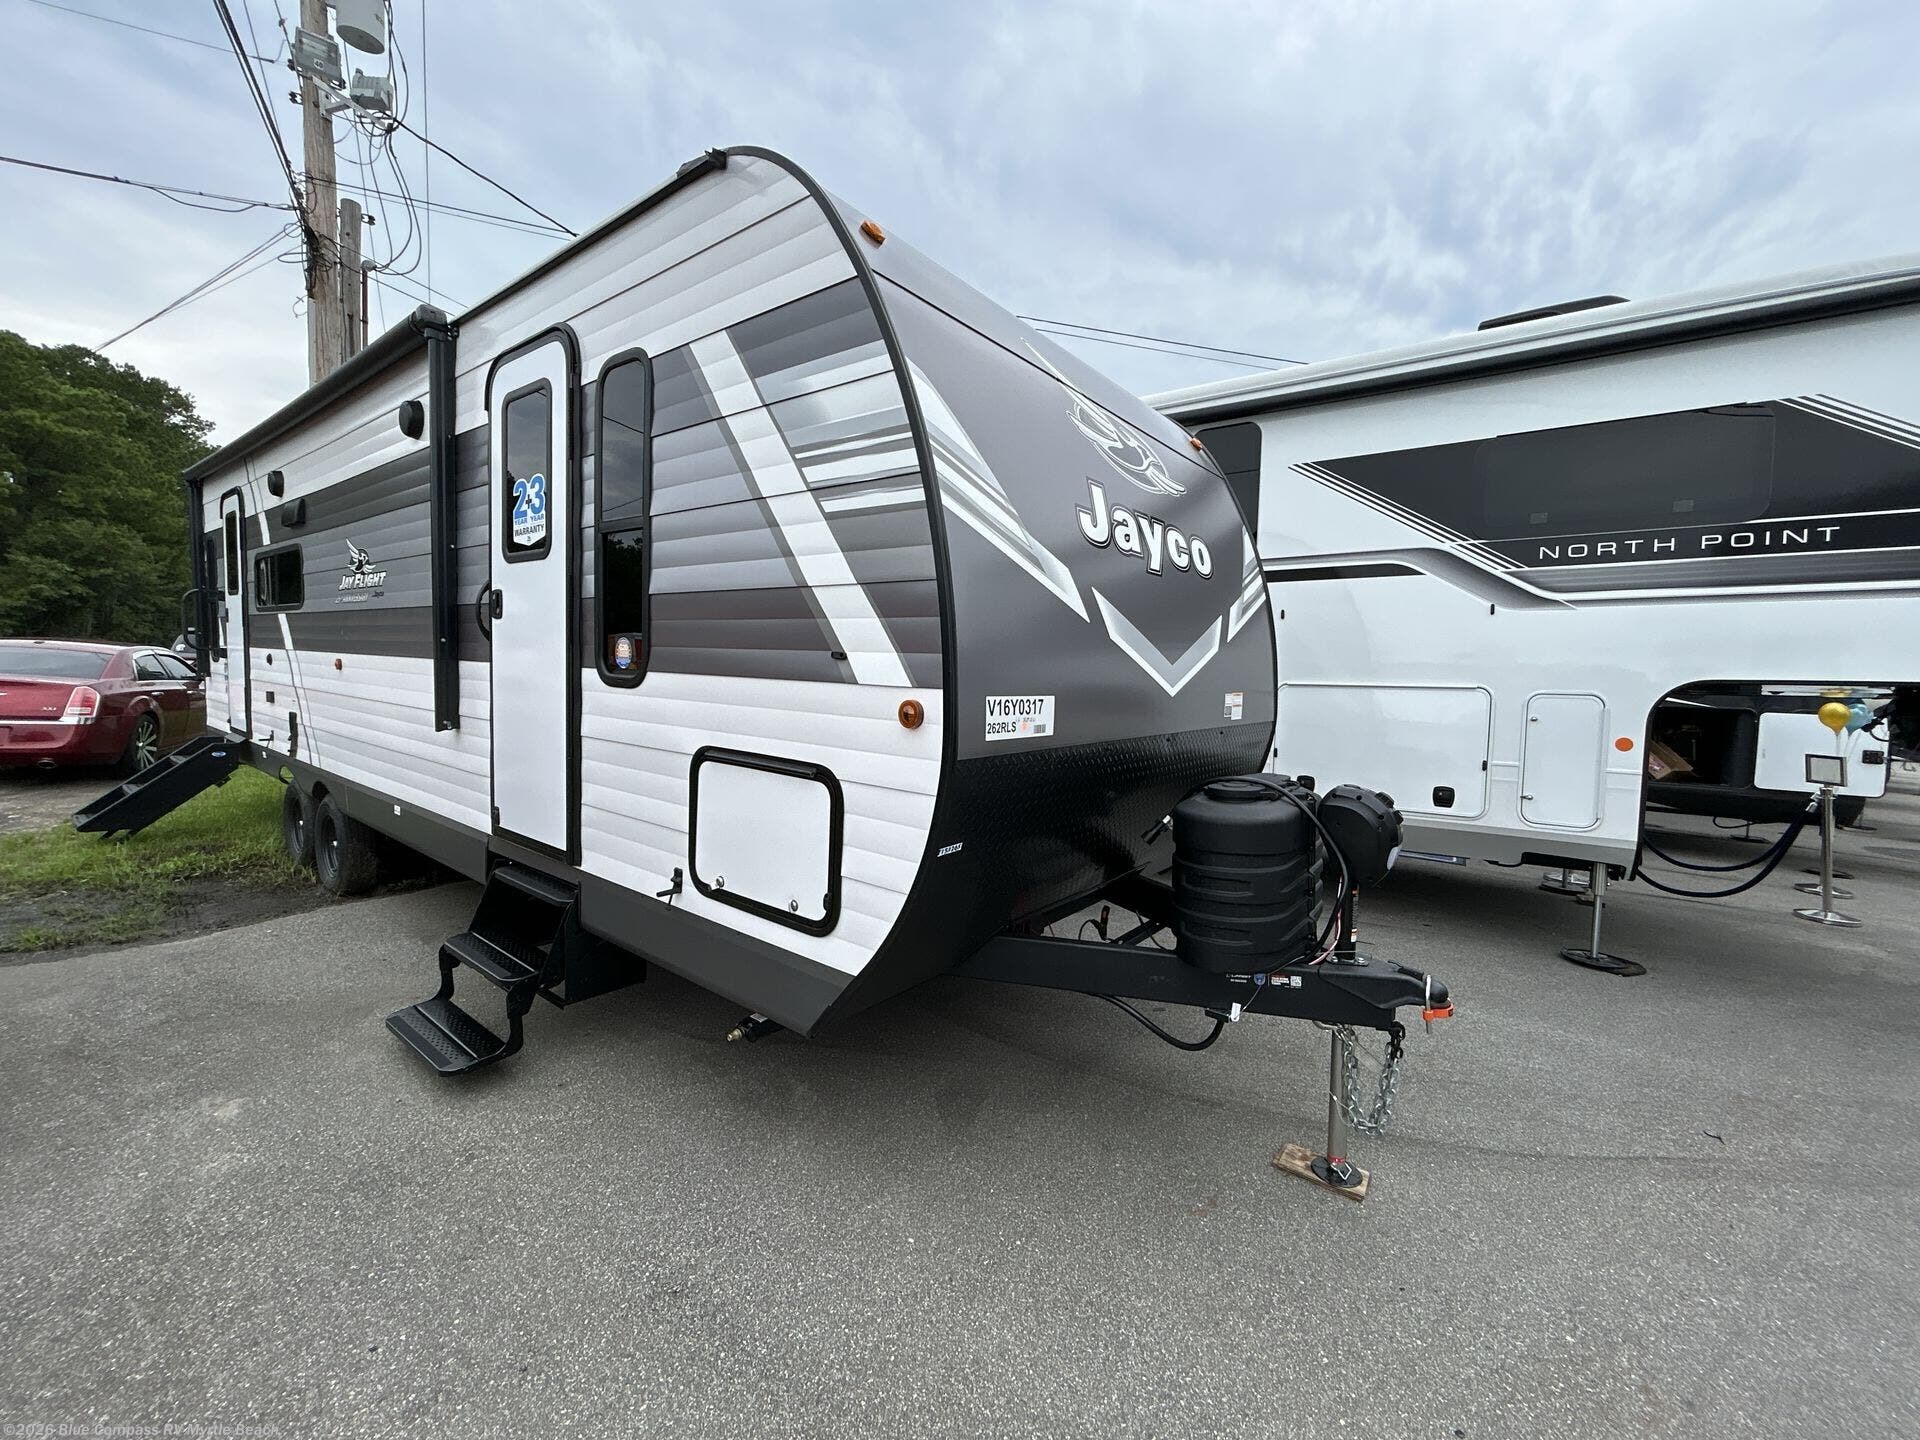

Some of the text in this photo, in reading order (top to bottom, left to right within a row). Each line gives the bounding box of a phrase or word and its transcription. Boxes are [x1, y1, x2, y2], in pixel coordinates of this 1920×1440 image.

[514, 524, 545, 537] WARRANTY
[1076, 477, 1213, 578] Jayco
[1539, 526, 1841, 560] NORTH POINT
[339, 571, 387, 590] JAY FLIGHT
[987, 698, 1044, 716] V16Y0317
[987, 721, 1017, 734] 262RLS
